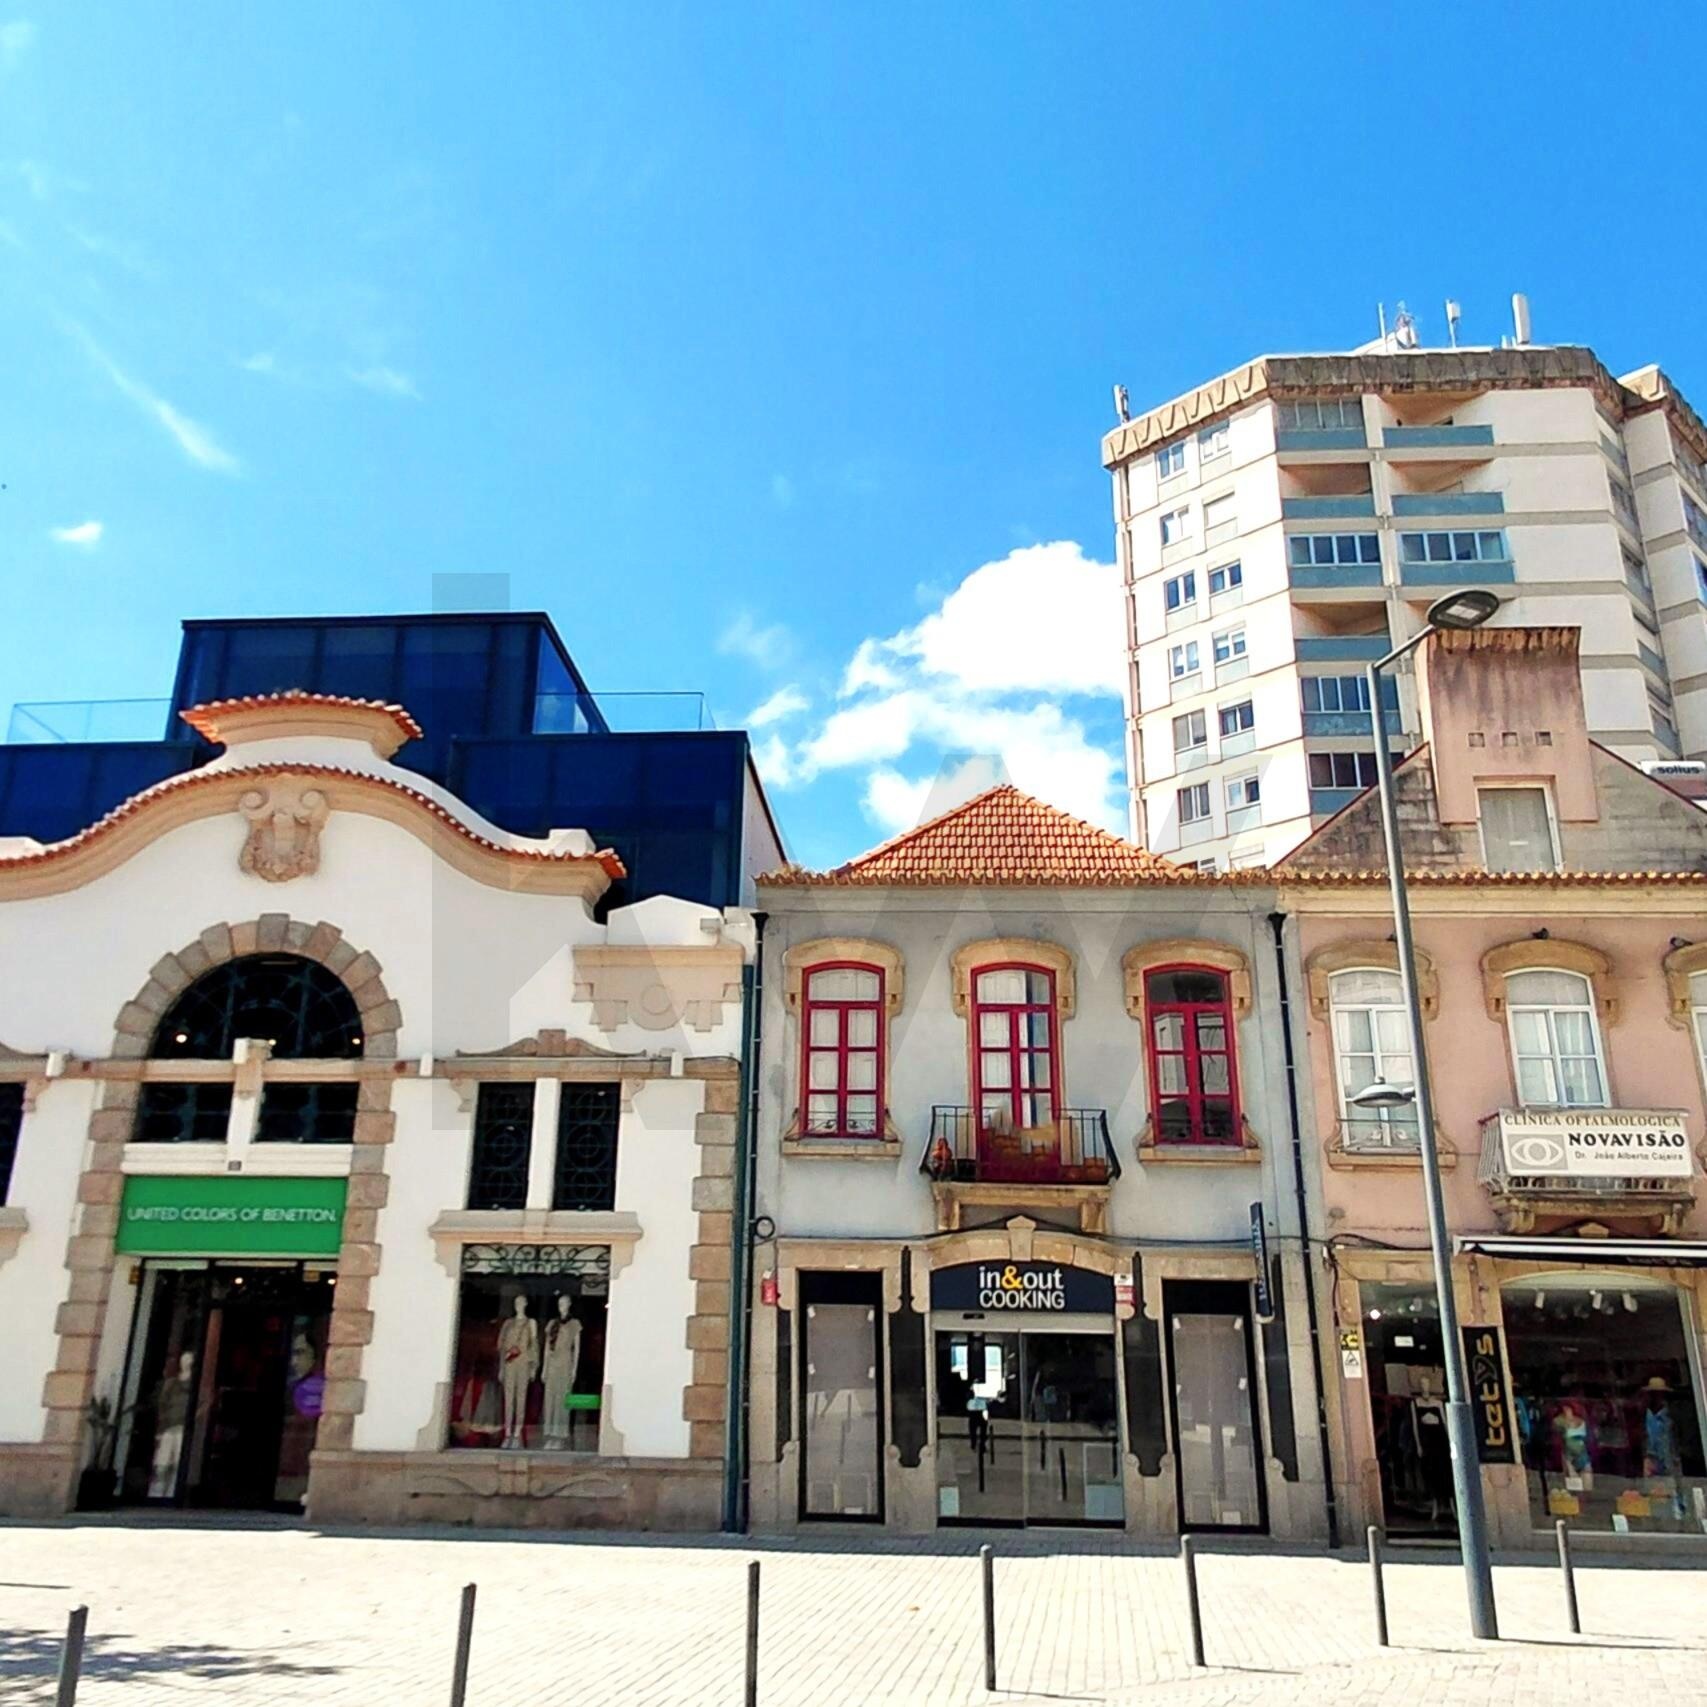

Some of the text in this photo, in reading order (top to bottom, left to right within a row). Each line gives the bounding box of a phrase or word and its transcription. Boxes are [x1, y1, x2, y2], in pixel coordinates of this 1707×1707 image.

[1568, 1130, 1685, 1147] NOVAVISÃO
[1618, 1151, 1649, 1160] Alberto
[127, 1207, 179, 1221] UNITED
[181, 1207, 238, 1221] COLORS
[240, 1208, 260, 1221] OF
[979, 1265, 1064, 1290] in&out
[979, 1289, 1065, 1309] COOKING
